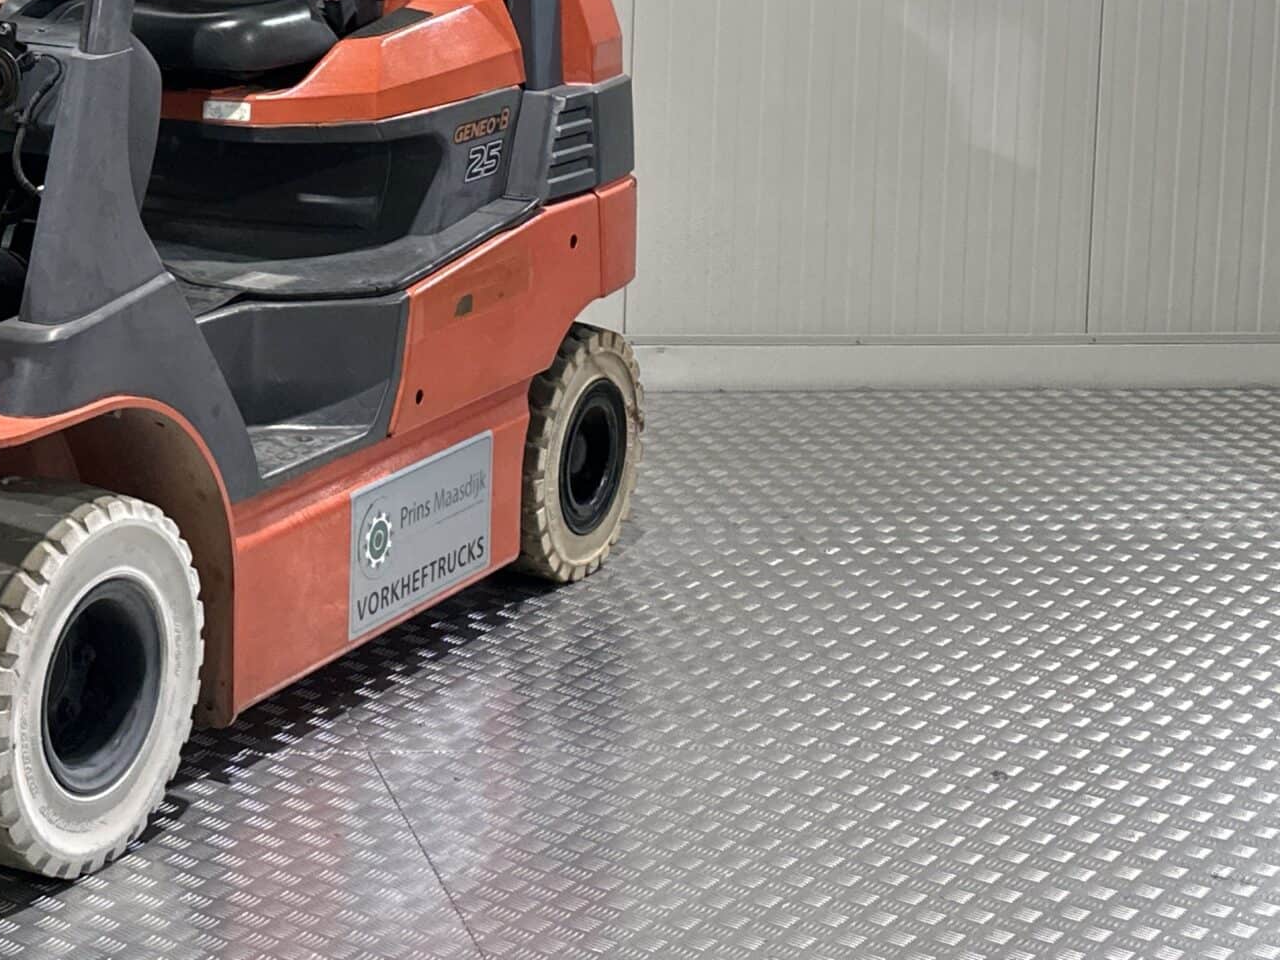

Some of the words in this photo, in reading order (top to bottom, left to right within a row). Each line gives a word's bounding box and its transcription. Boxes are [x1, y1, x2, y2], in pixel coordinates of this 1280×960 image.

[464, 140, 503, 183] 25
[400, 498, 432, 530] Prins
[433, 469, 487, 511] Maasdijk
[356, 535, 485, 621] VORKHEFTRUCKS
